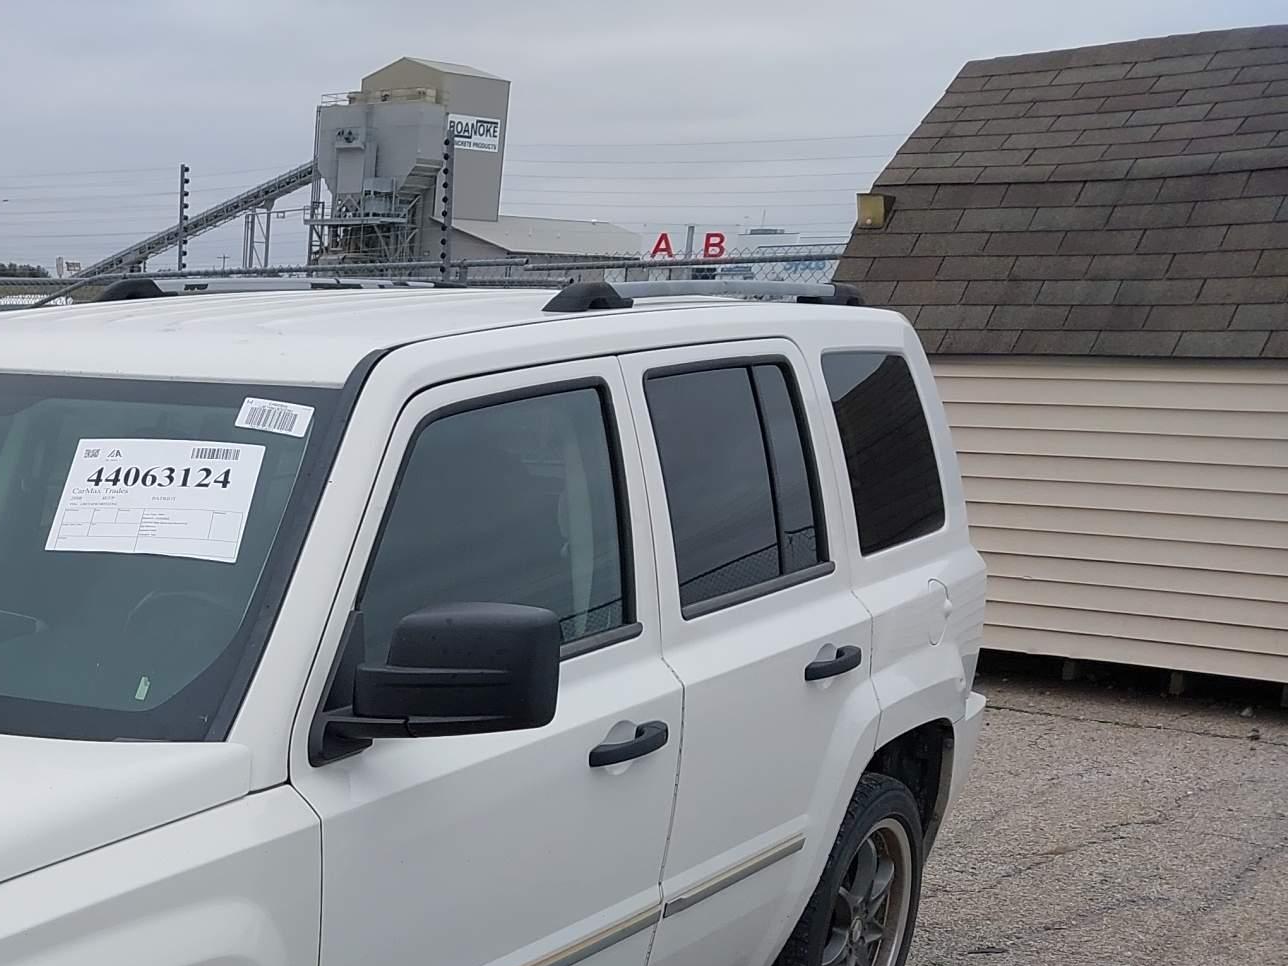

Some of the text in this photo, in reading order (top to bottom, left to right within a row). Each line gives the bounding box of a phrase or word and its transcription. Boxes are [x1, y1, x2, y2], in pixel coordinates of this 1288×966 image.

[449, 119, 499, 139] ROANOKE
[650, 232, 674, 258] A
[703, 232, 726, 258] B
[86, 466, 231, 489] 44063124
[72, 487, 101, 495] CarMax
